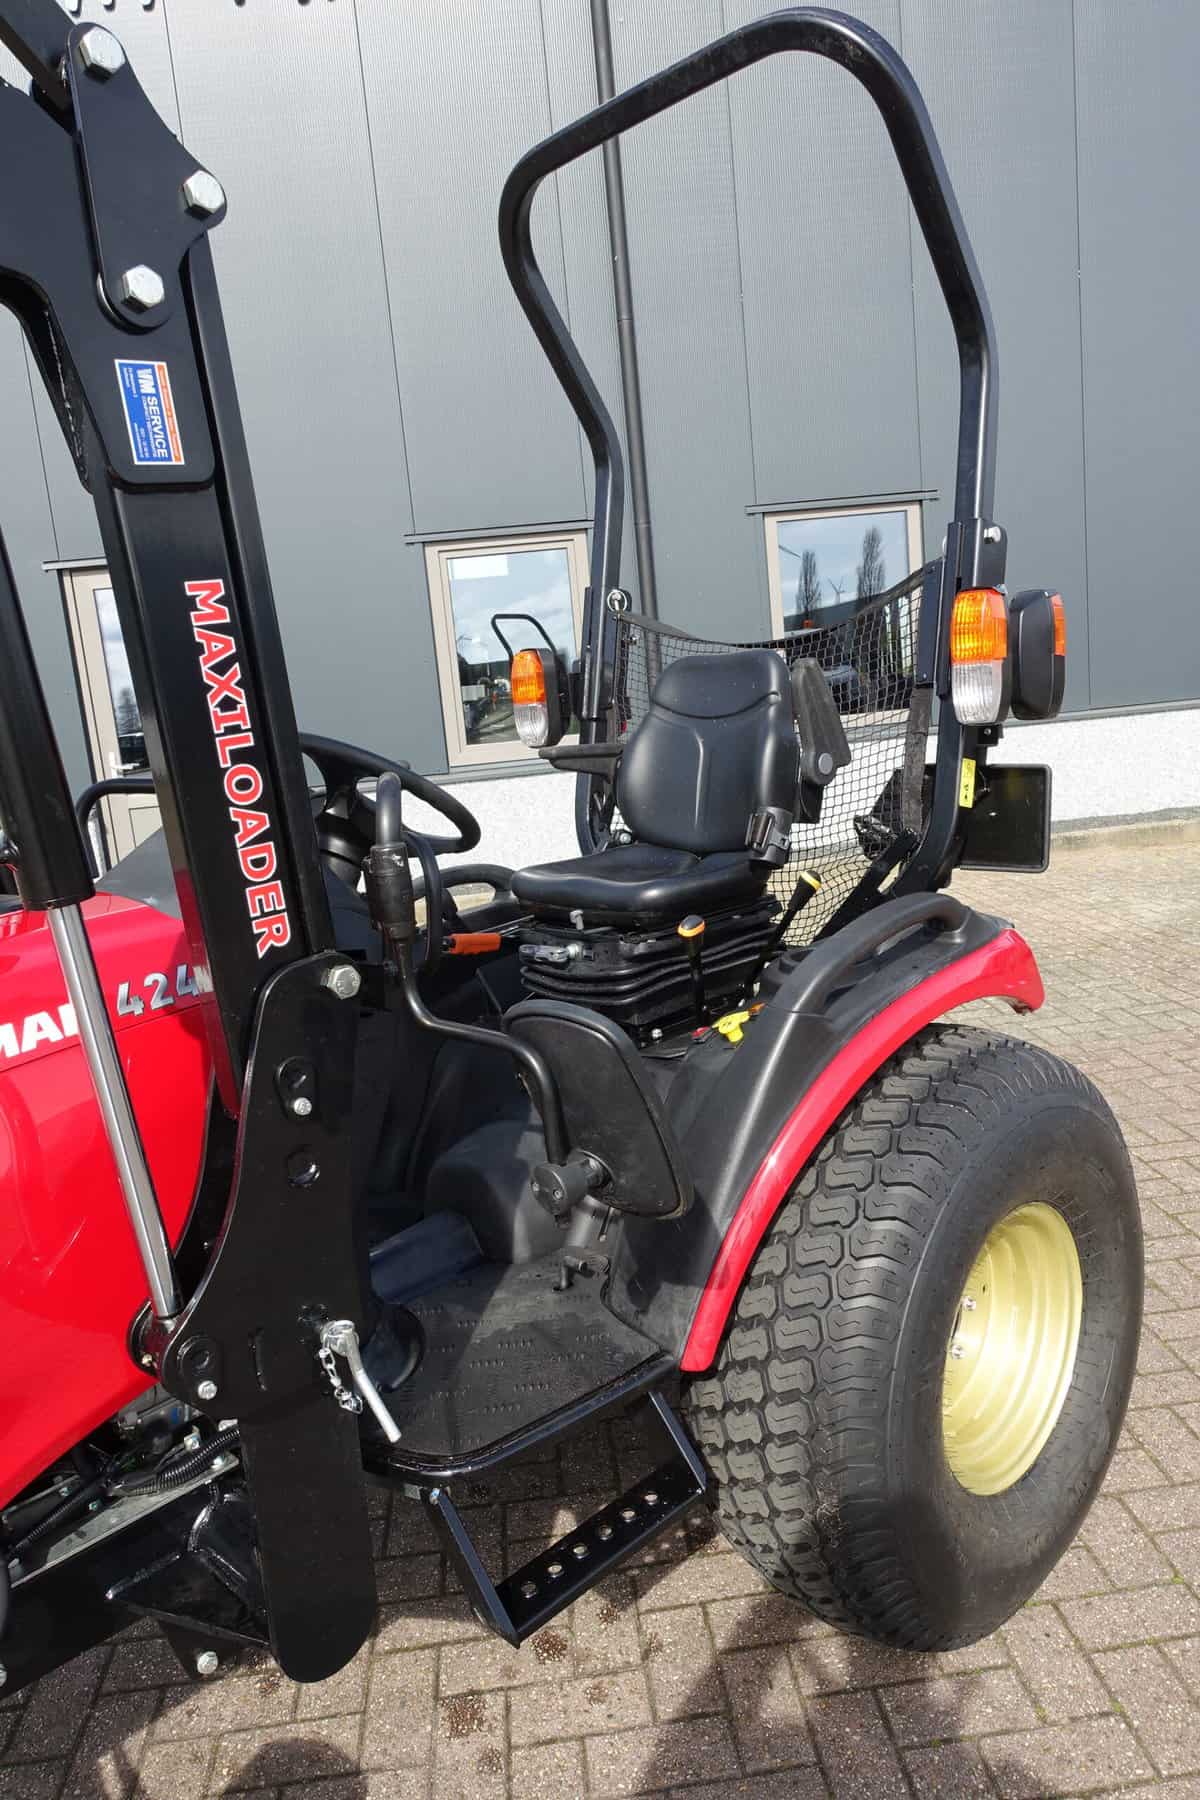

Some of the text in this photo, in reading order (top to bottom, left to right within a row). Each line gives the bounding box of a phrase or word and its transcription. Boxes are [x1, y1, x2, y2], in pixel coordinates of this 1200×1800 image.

[137, 368, 156, 394] VM
[147, 396, 168, 458] SERVICE
[184, 579, 291, 959] MAXILOADER
[117, 964, 200, 1016] 424
